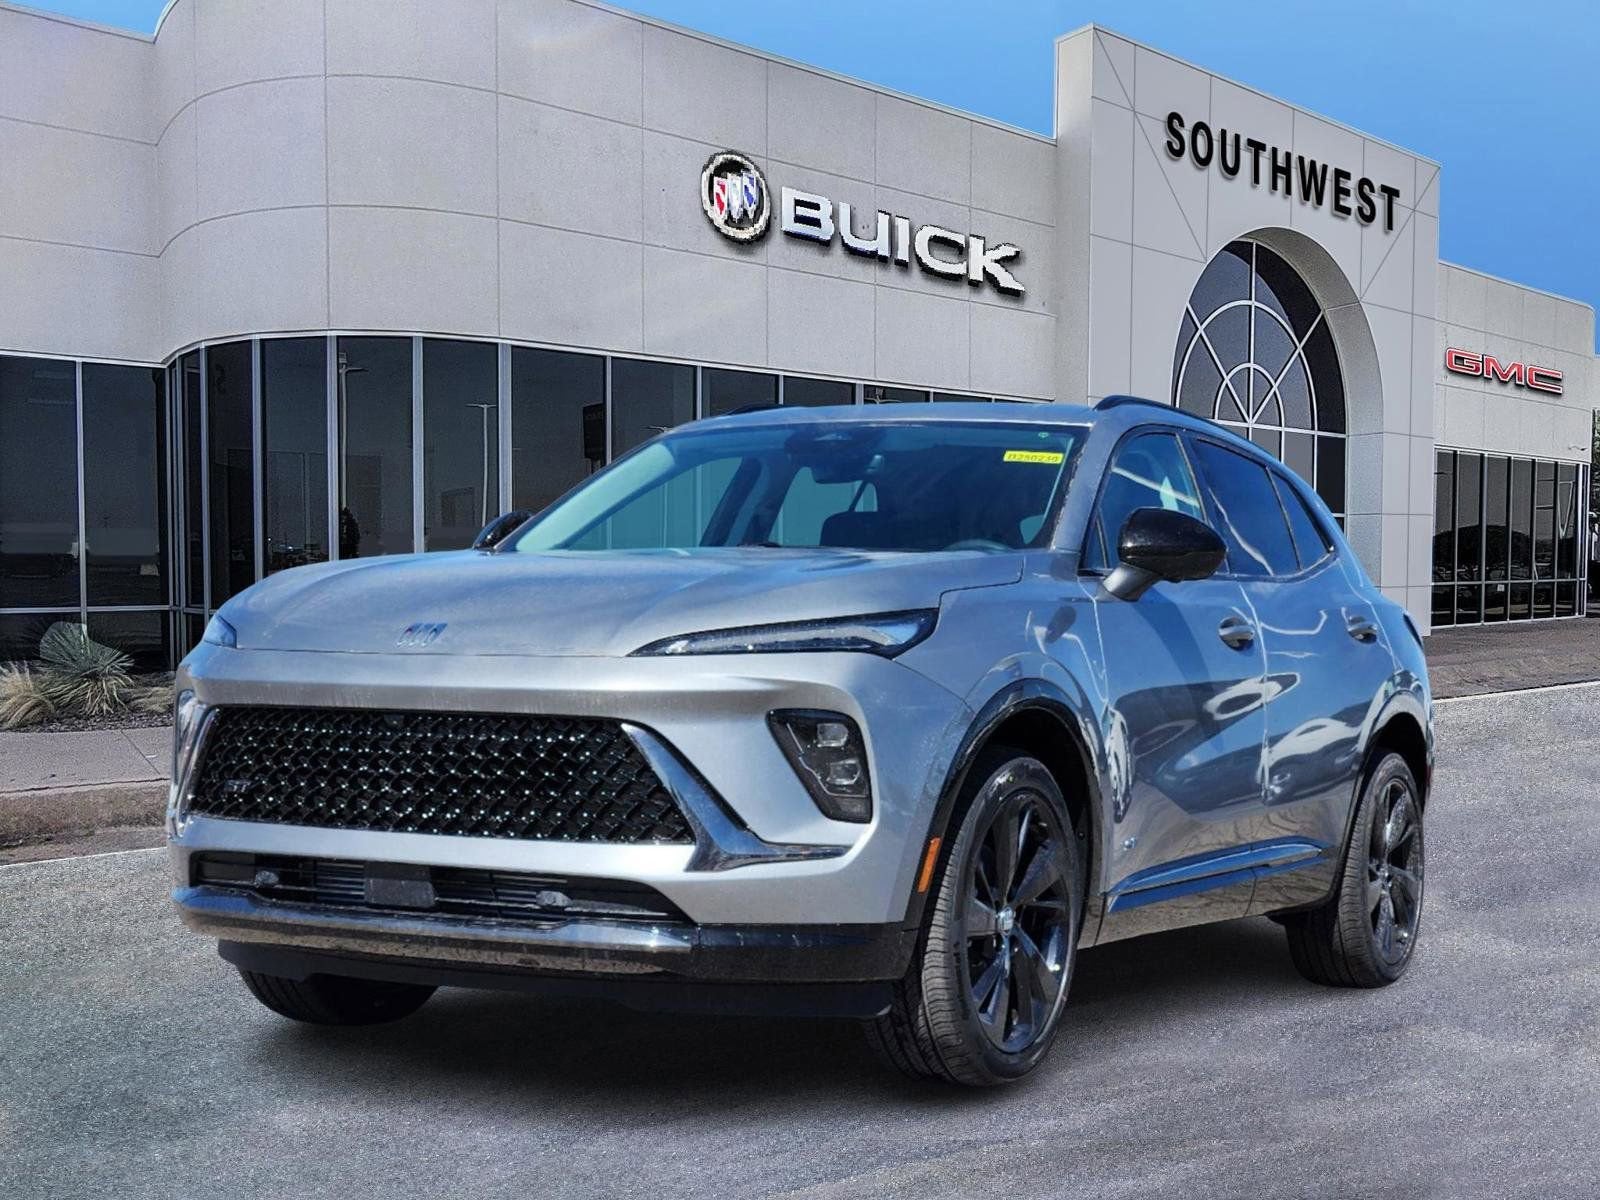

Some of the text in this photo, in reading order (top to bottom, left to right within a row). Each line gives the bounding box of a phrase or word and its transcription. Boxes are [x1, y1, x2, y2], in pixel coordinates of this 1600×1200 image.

[1166, 111, 1400, 231] SOUTHWEST
[781, 186, 1025, 297] BUICK
[1446, 347, 1563, 395] GMC
